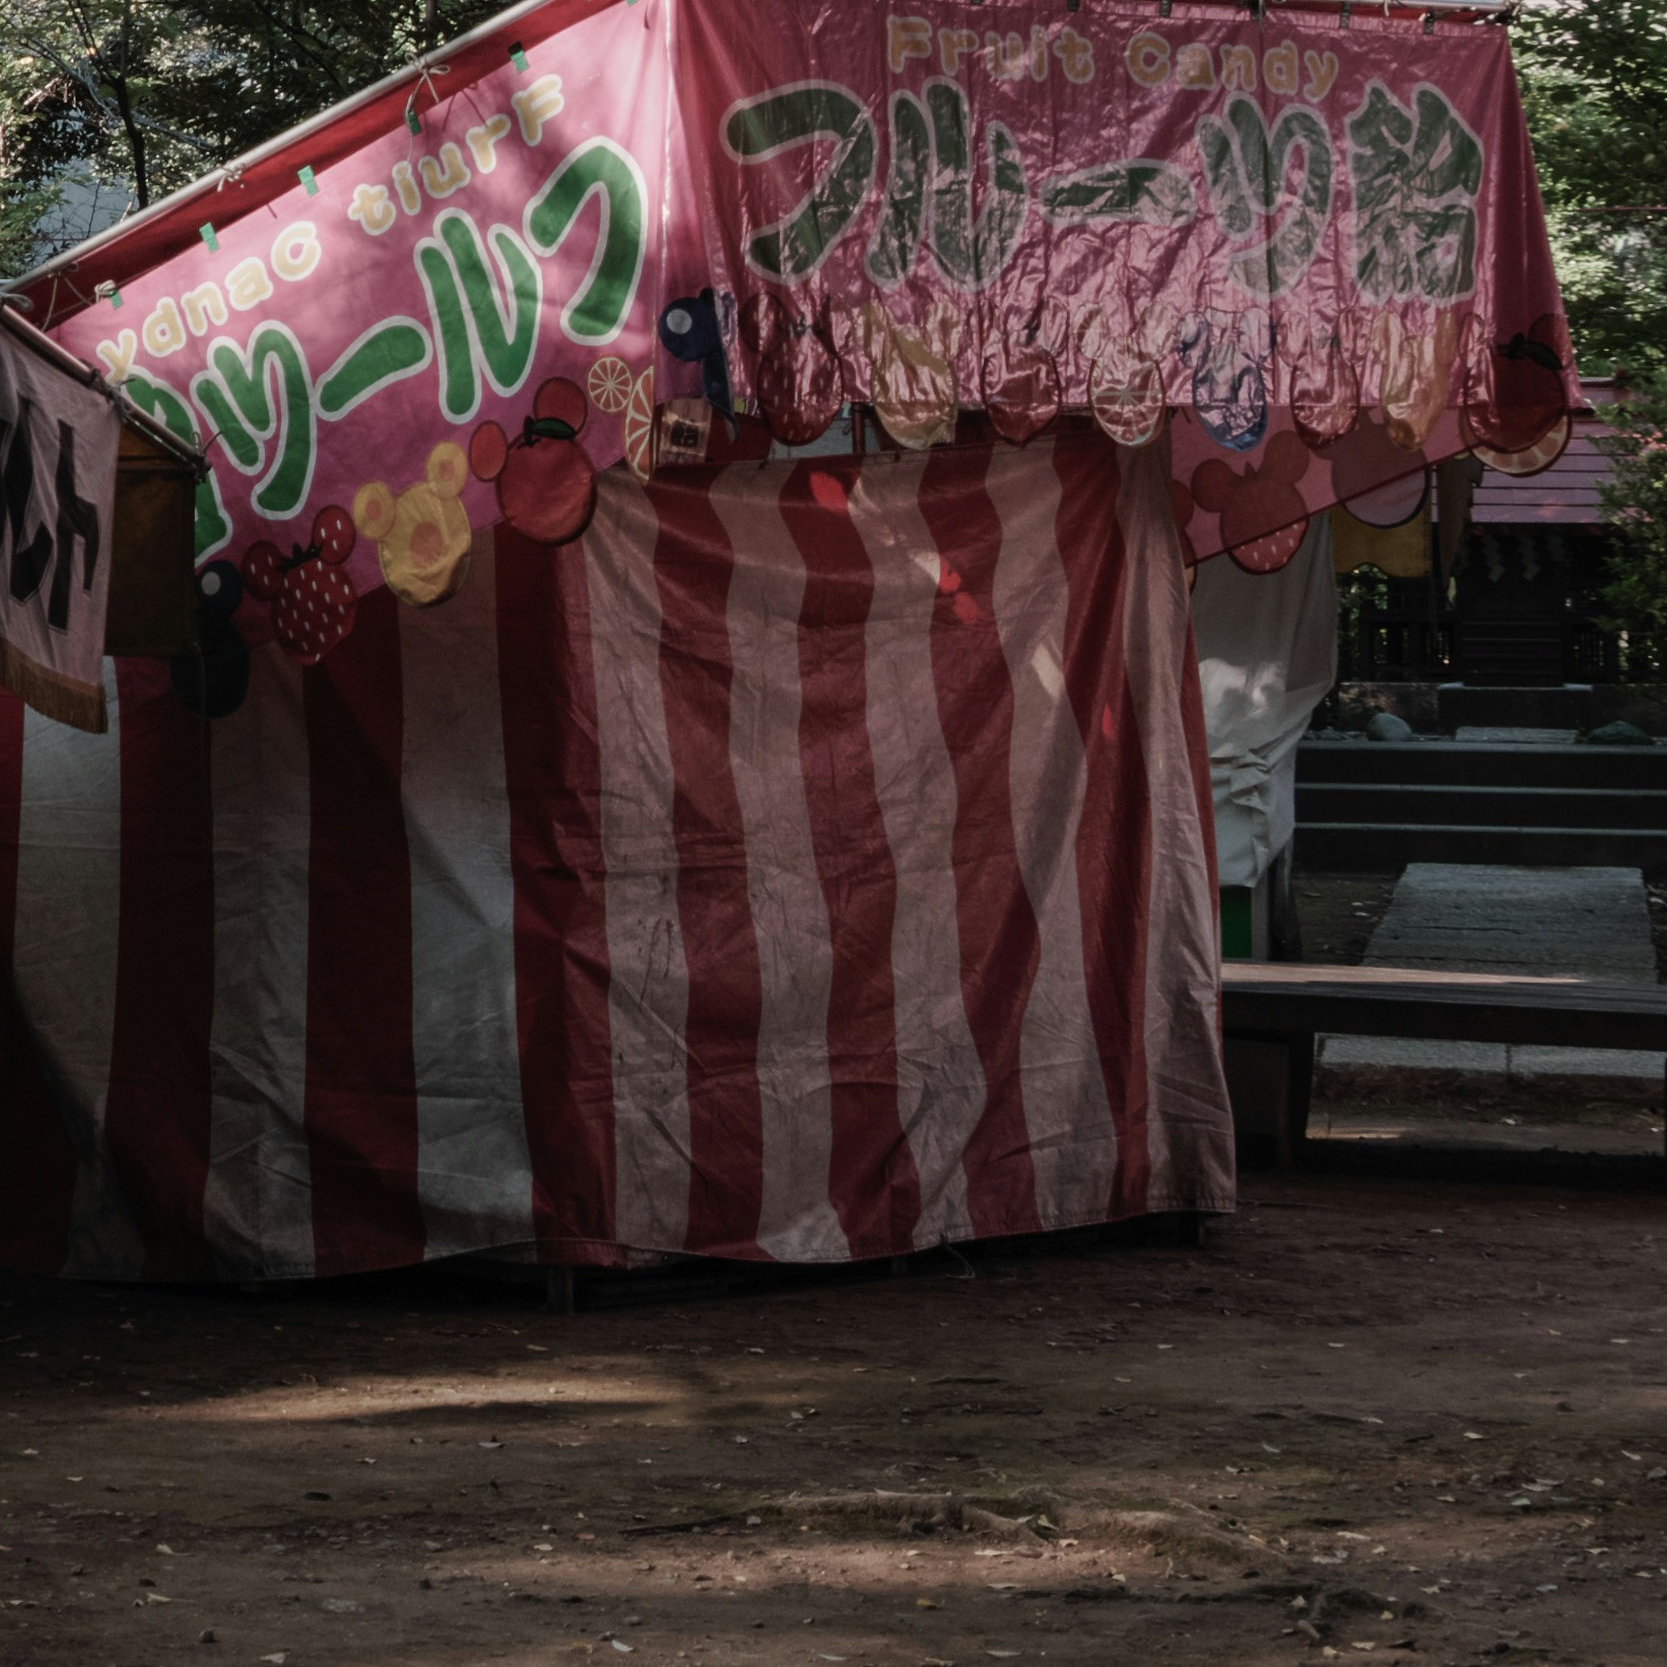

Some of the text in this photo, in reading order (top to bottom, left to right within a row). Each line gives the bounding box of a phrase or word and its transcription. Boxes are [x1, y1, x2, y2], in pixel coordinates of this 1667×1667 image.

[886, 15, 1338, 102] Fruit Candy
[720, 75, 1485, 305] フルーツ飴
